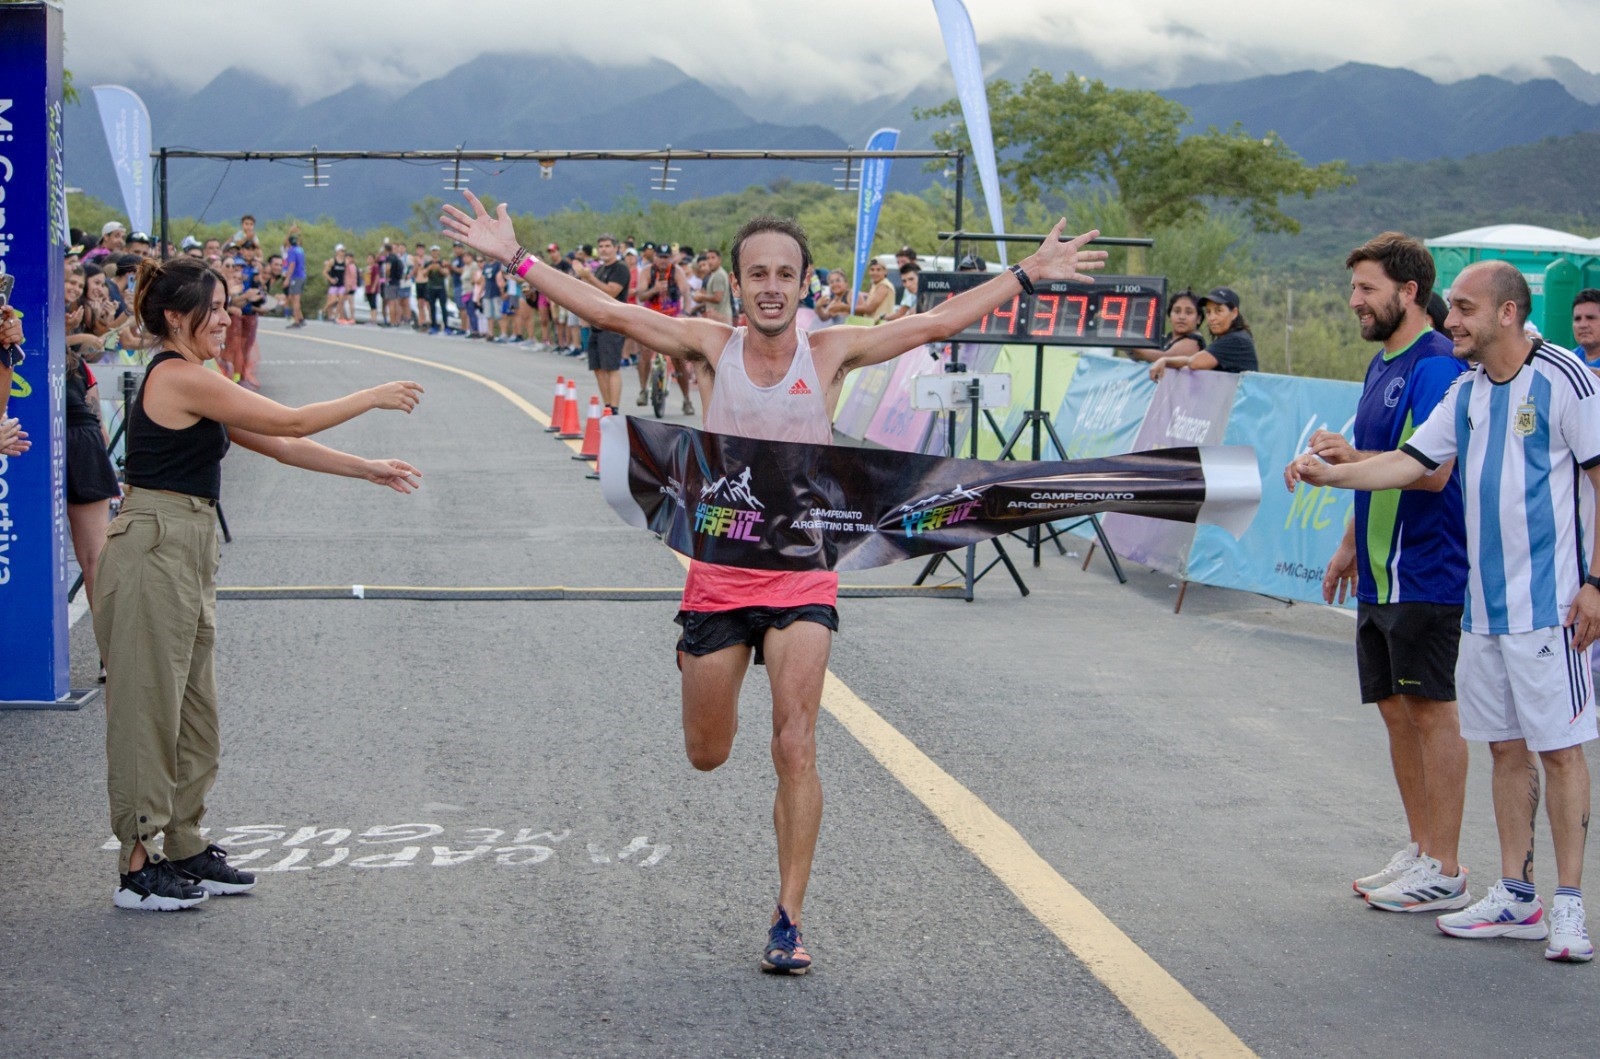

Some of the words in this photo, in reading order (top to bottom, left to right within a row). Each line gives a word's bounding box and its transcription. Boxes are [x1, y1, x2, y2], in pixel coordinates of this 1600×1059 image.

[55, 131, 65, 246] CAPITAL
[928, 281, 950, 289] HORA
[1051, 284, 1067, 292] SEG
[1115, 284, 1141, 293] 1/100
[1165, 406, 1211, 444] Catamarca
[1030, 492, 1134, 500] CAMPEONATO
[705, 506, 765, 523] CAPITAL
[809, 507, 862, 519] CAMPEONATO
[901, 507, 978, 538] TRAIL
[694, 513, 761, 542] TRAIL
[790, 520, 842, 531] ARGENTINO
[843, 523, 854, 532] DE
[855, 523, 877, 532] TRAIL
[1275, 561, 1324, 583] #MiCapit
[101, 824, 445, 848] GUS
[224, 845, 554, 872] CAPITA
